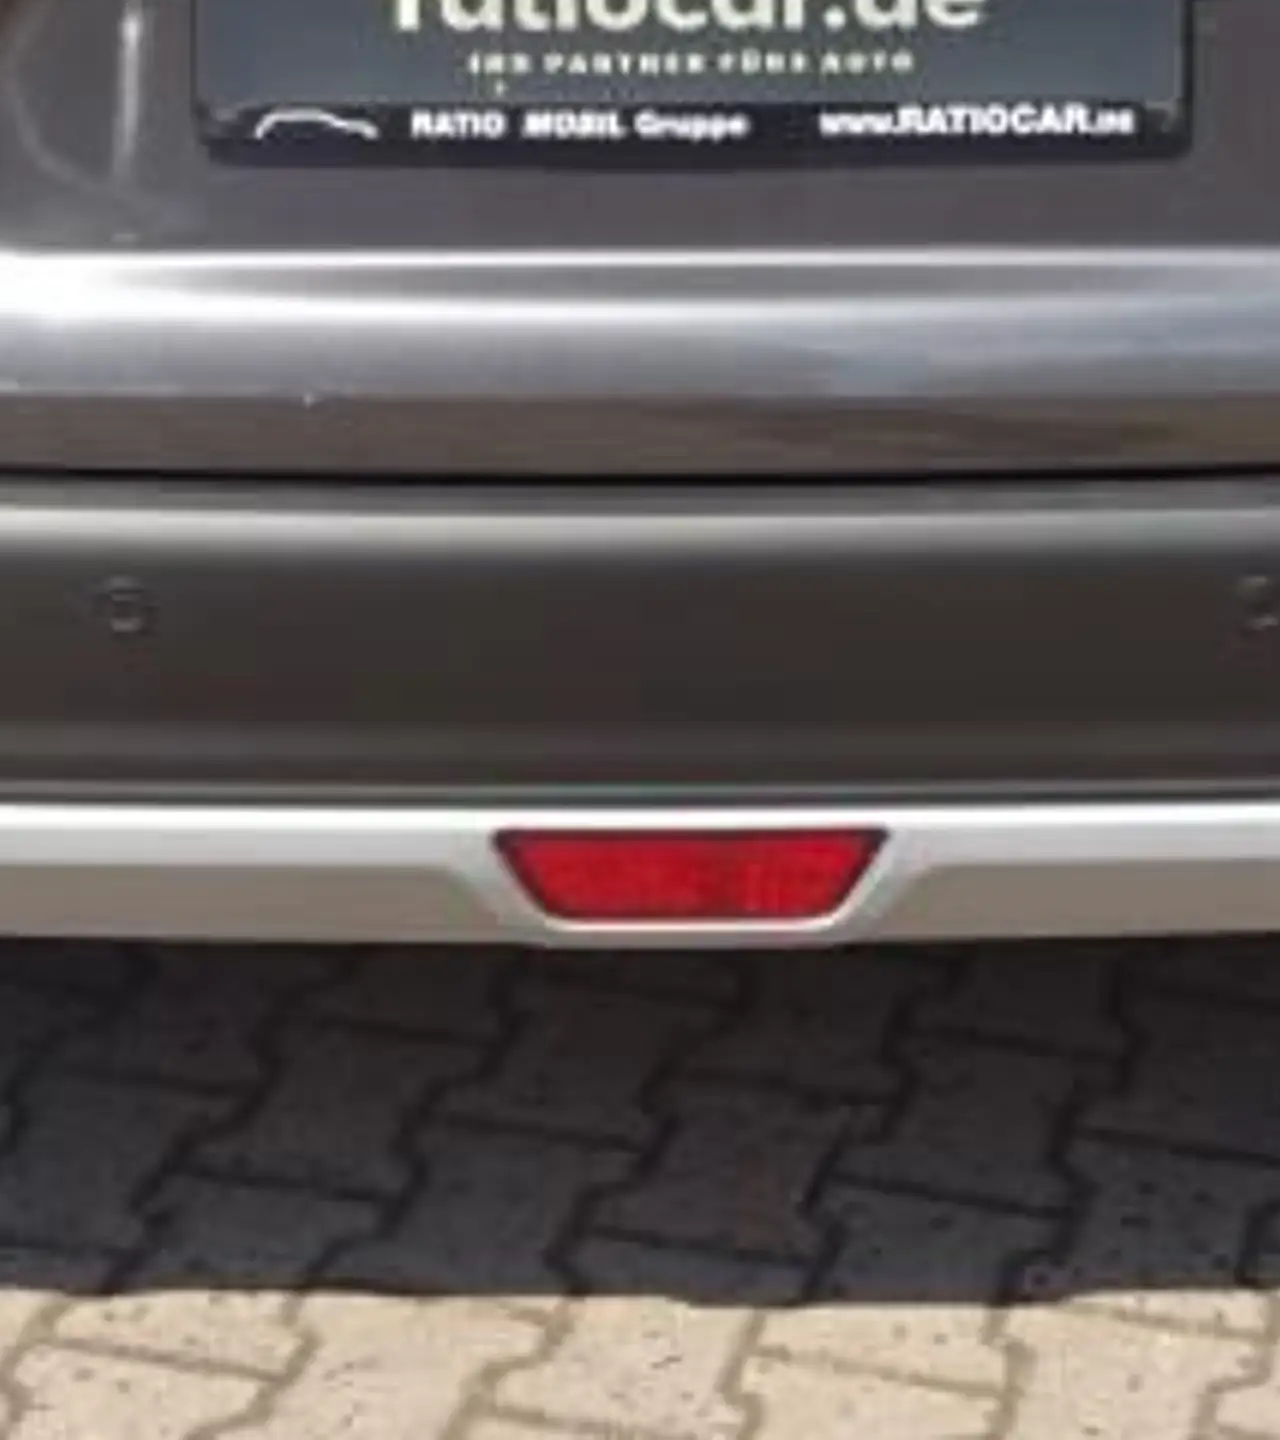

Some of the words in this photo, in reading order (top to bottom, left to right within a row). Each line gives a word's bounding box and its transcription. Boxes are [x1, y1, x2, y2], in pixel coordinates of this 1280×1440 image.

[542, 51, 706, 75] PARTNER
[821, 51, 915, 74] AUTO
[411, 109, 508, 139] RATIO
[522, 109, 626, 140] MOBIL
[633, 110, 750, 143] Gruppe
